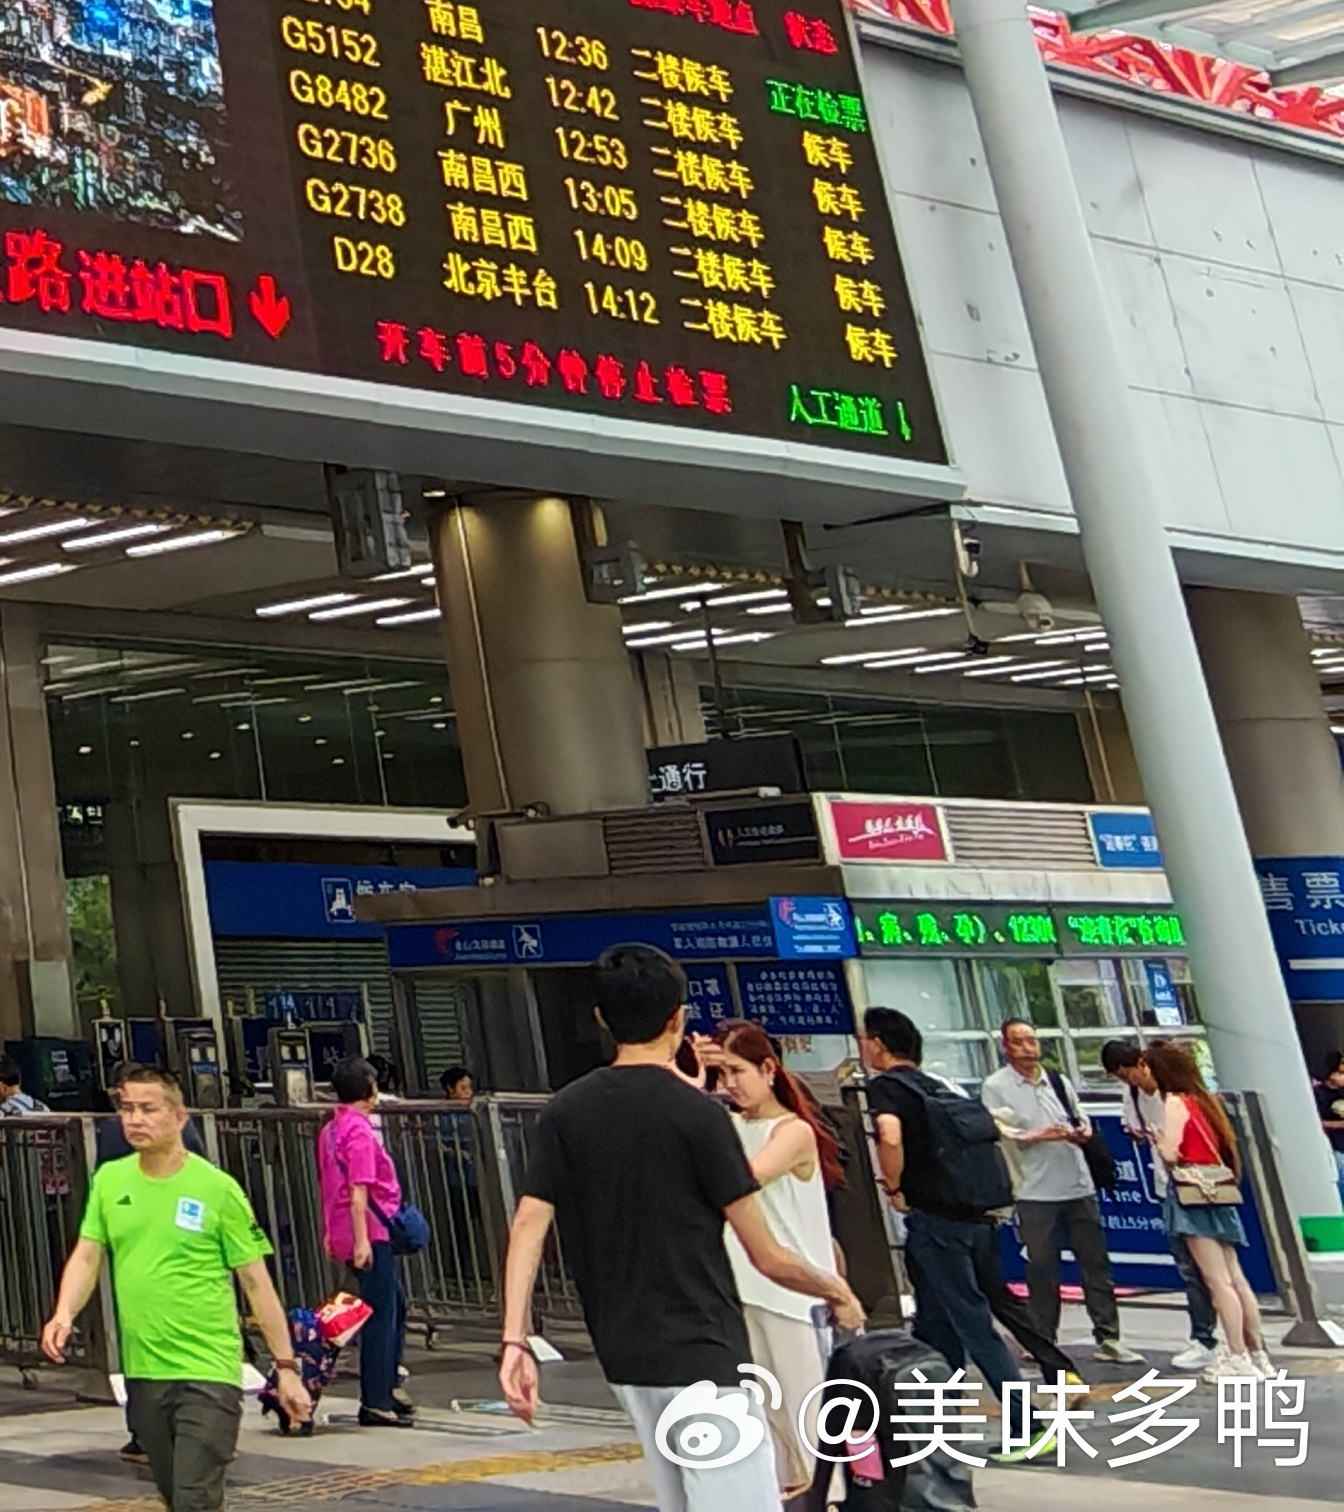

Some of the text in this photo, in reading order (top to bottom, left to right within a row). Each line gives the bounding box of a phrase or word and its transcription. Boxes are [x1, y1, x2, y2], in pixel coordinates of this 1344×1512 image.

[282, 15, 854, 175] G5152 湛江北 12:42 二楼候车 候车
[536, 26, 609, 71] 12:36
[631, 47, 734, 103] 二楼候车
[764, 77, 869, 134] 正在检票
[290, 69, 865, 223] G8482 广州 12:53 二楼候车 候车
[298, 124, 876, 266] G2736 南昌西 13:05 二楼候车 候车
[306, 178, 886, 318] G2738 南昌西 14:09 二楼候车 候车
[334, 235, 899, 369] D28 北京丰台 14:12 二楼候车 候车
[376, 319, 732, 415] 开车前5分钟停止检票
[789, 383, 889, 437] 人工通道
[648, 762, 707, 792] 通行
[1294, 918, 1344, 936] Tick
